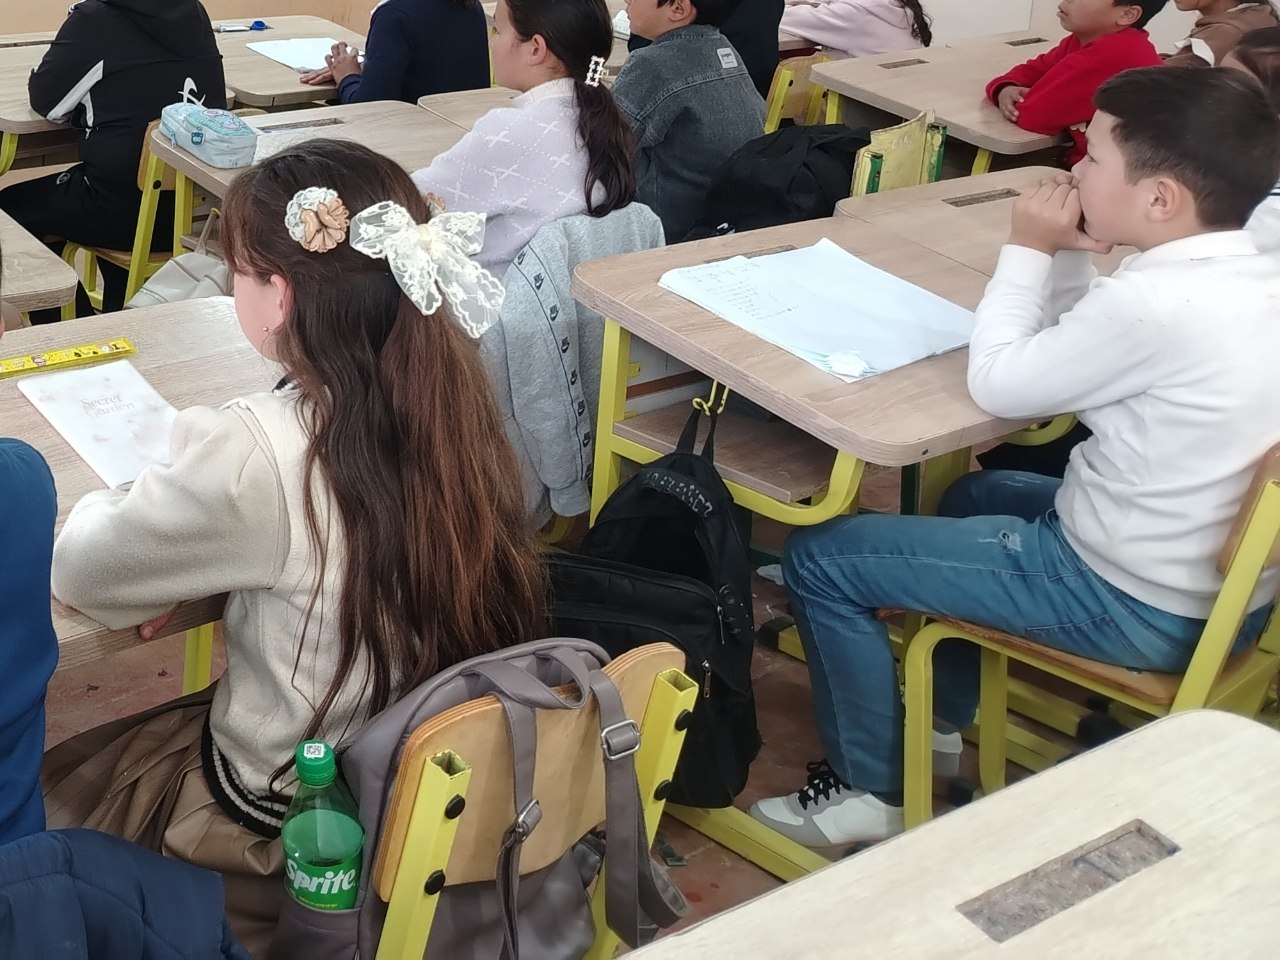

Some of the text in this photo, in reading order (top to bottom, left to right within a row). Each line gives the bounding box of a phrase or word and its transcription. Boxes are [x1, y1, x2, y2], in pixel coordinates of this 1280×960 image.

[78, 392, 123, 409] Secret
[85, 401, 136, 419] Garden
[286, 858, 356, 894] Sprite
